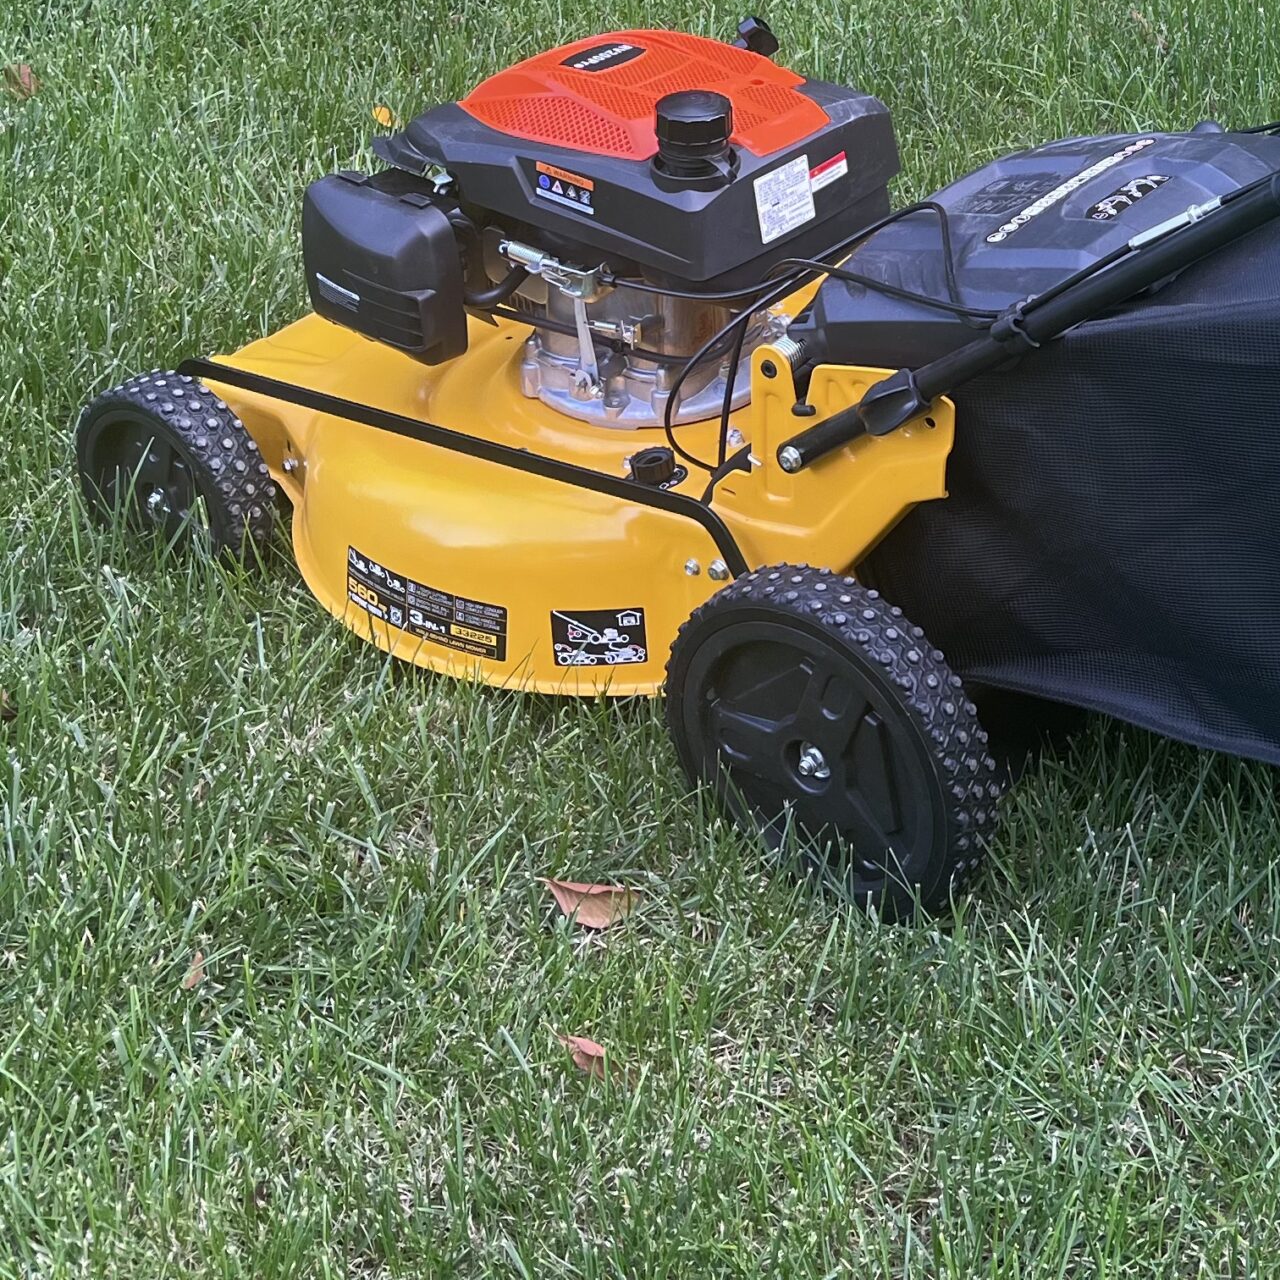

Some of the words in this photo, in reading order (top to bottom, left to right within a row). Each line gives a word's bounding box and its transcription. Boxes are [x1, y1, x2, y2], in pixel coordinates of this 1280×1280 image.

[348, 577, 378, 606] 560
[409, 609, 446, 634] 3-IN-1
[454, 627, 493, 644] 33225
